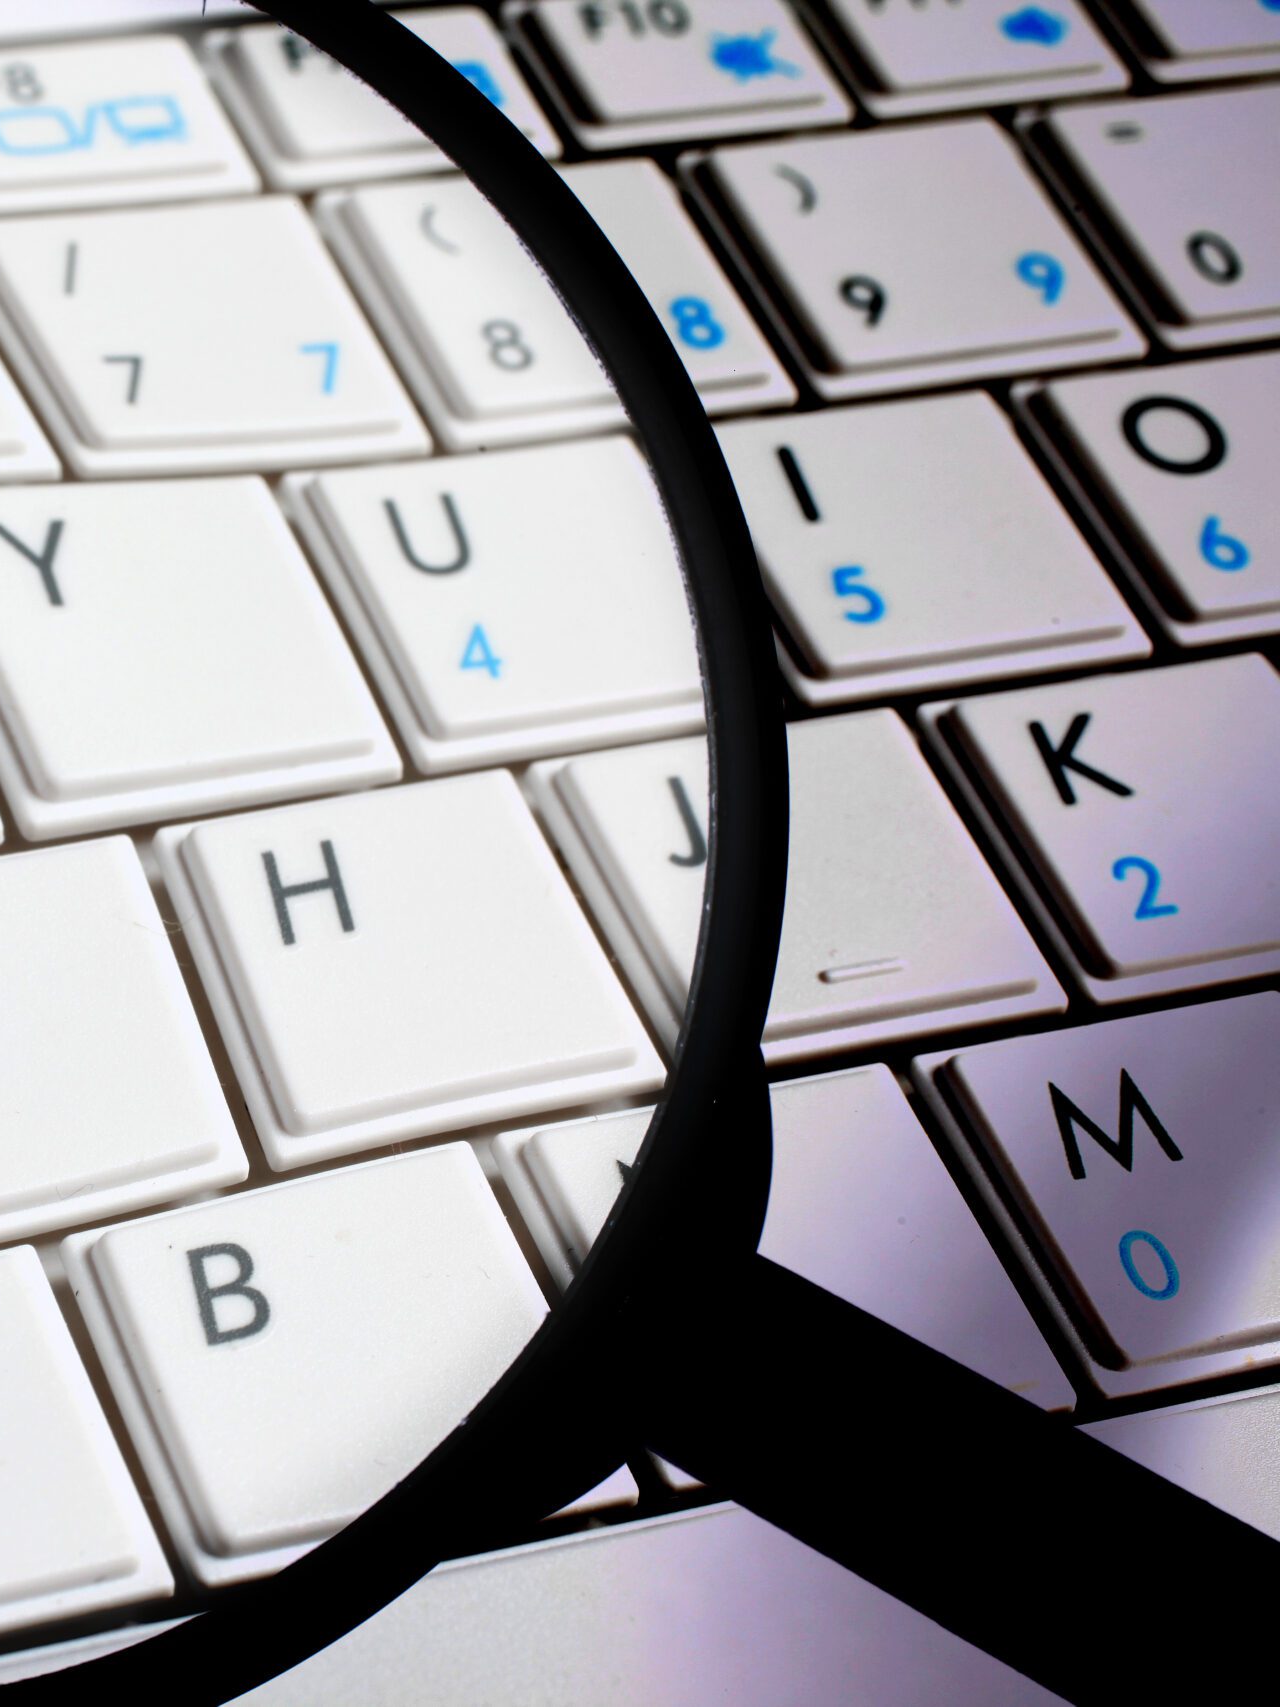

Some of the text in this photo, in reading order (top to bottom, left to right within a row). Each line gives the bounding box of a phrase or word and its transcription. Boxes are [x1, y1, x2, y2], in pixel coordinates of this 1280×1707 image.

[577, 0, 691, 42] F10
[775, 164, 818, 215] )
[418, 203, 462, 256] (
[1186, 231, 1243, 286] 0
[62, 241, 79, 297] /
[838, 251, 1066, 329] 9 9
[480, 295, 726, 373] 8 8
[103, 342, 341, 406] 7 7
[1120, 395, 1228, 476] O
[773, 444, 821, 524] I
[382, 492, 471, 578] U
[1199, 515, 1250, 573] 6
[830, 564, 887, 625] 5
[458, 623, 504, 680] 4
[1027, 711, 1135, 806] K
[667, 776, 708, 868] J
[260, 839, 356, 947] H
[1111, 855, 1180, 922] 2
[1047, 1067, 1185, 1181] M
[185, 1242, 271, 1347] B
